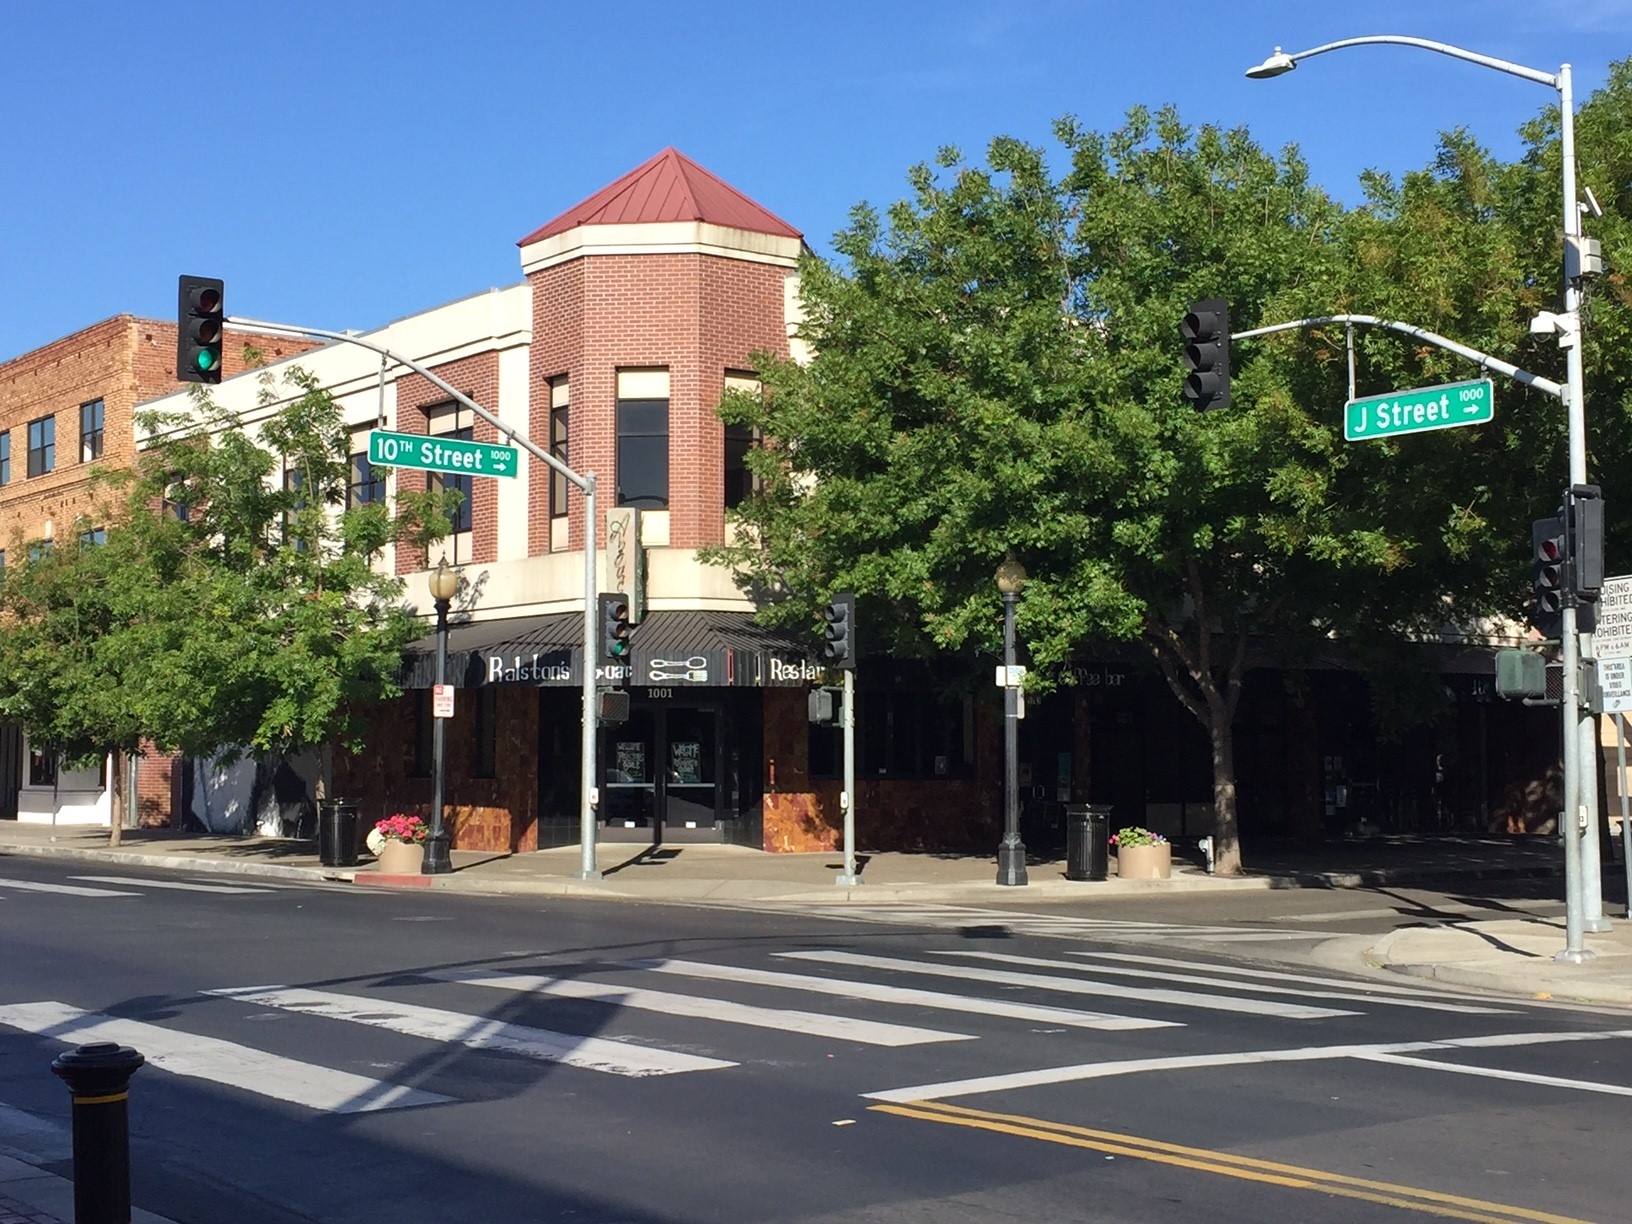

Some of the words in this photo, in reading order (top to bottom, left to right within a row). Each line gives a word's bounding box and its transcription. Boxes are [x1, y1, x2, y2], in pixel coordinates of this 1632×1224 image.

[1353, 406, 1367, 433] J
[1376, 393, 1450, 429] Street
[1458, 387, 1484, 402] 1000
[377, 437, 413, 461] 10TH
[420, 442, 483, 470] Street
[490, 450, 512, 461] 1000
[1594, 624, 1632, 638] OHIBITE
[488, 653, 570, 683] Ralston's
[647, 688, 673, 699] 1001
